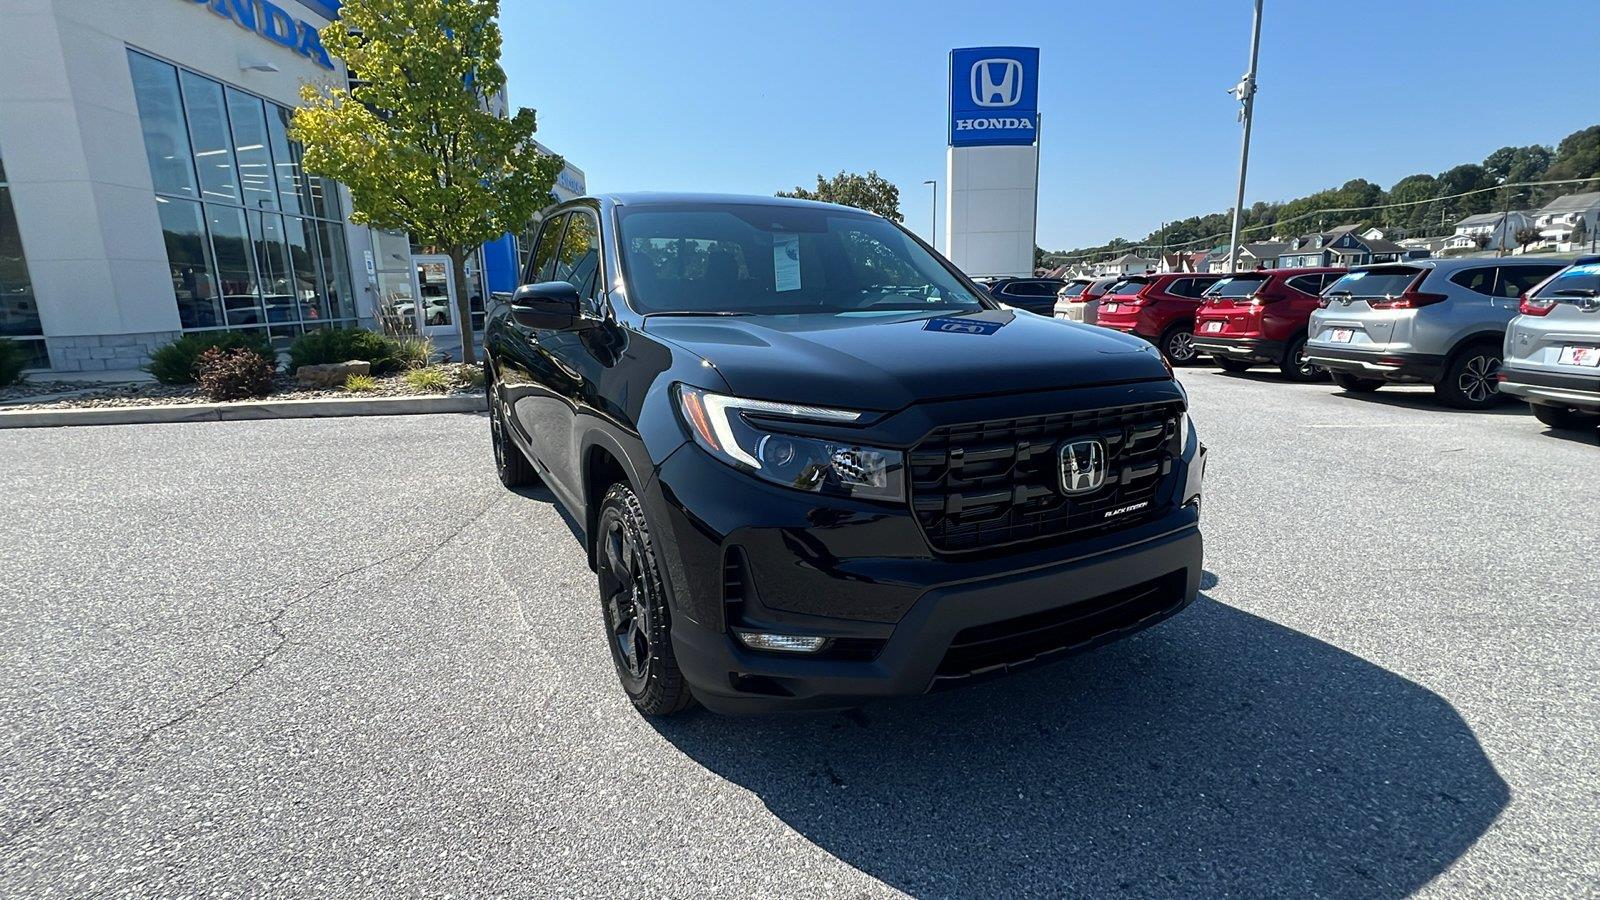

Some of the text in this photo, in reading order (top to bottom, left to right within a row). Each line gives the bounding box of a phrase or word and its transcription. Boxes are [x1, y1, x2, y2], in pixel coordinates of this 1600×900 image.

[956, 118, 1034, 131] HONDA
[1104, 501, 1149, 518] BLACK EDITION
